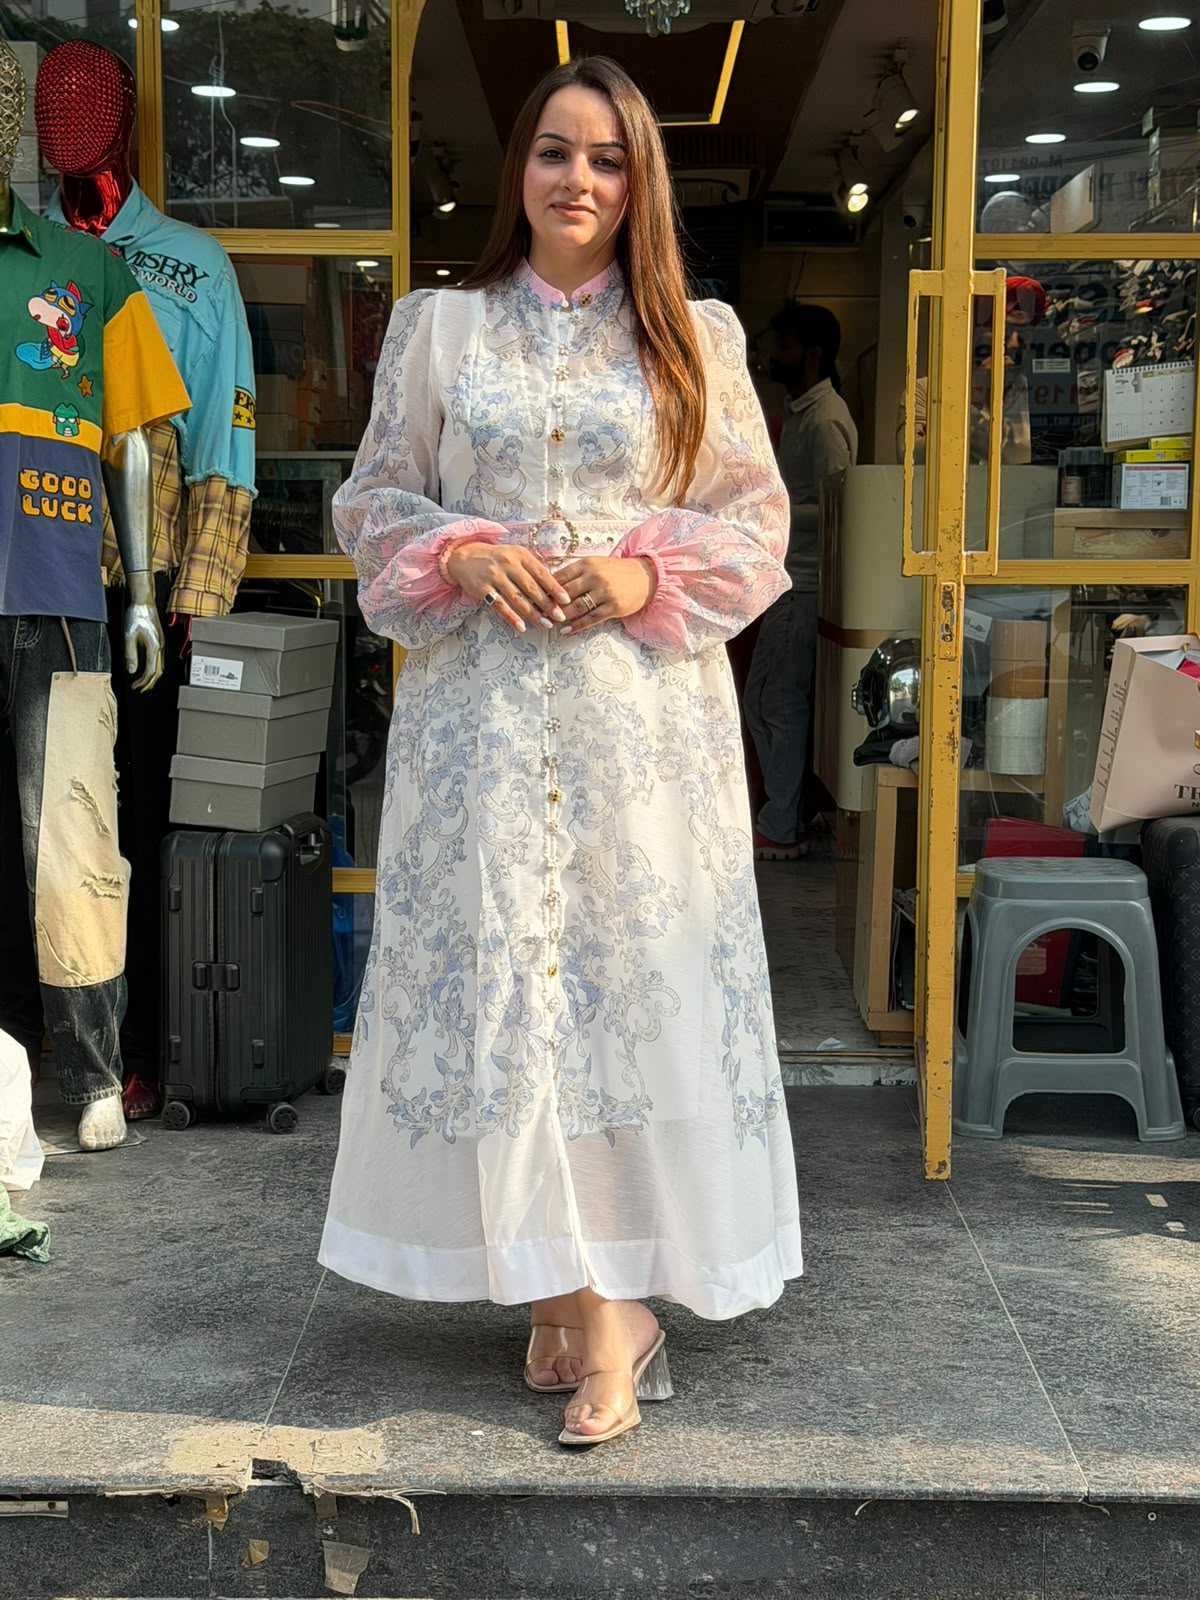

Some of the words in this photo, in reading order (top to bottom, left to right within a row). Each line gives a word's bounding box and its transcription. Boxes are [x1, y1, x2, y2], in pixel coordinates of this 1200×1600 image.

[140, 270, 198, 304] WORLD
[19, 468, 92, 500] GOOD
[21, 493, 93, 524] LUCK
